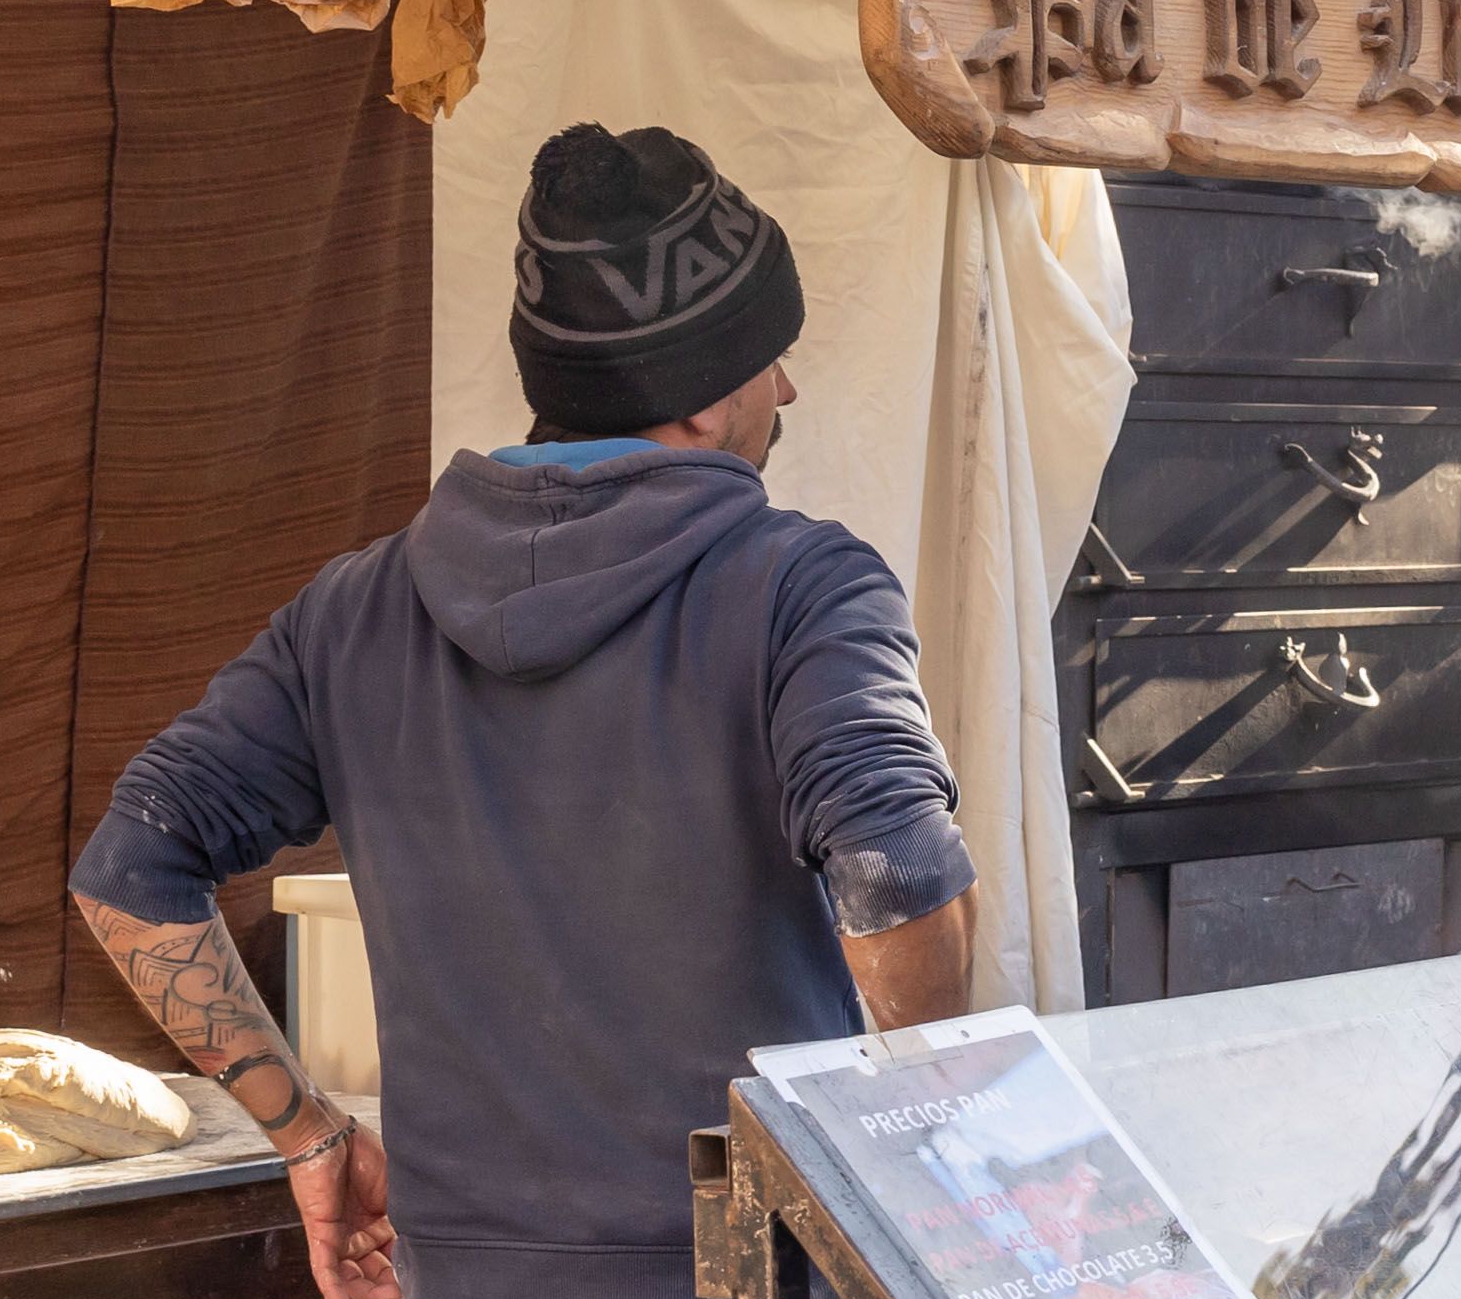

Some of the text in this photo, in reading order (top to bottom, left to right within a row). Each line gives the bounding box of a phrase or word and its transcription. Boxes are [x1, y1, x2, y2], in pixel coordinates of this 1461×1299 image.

[858, 1088, 1011, 1137] PRECIOS PAN
[1001, 1278, 1033, 1299] DE
[1028, 1249, 1145, 1293] CHOCOLATE
